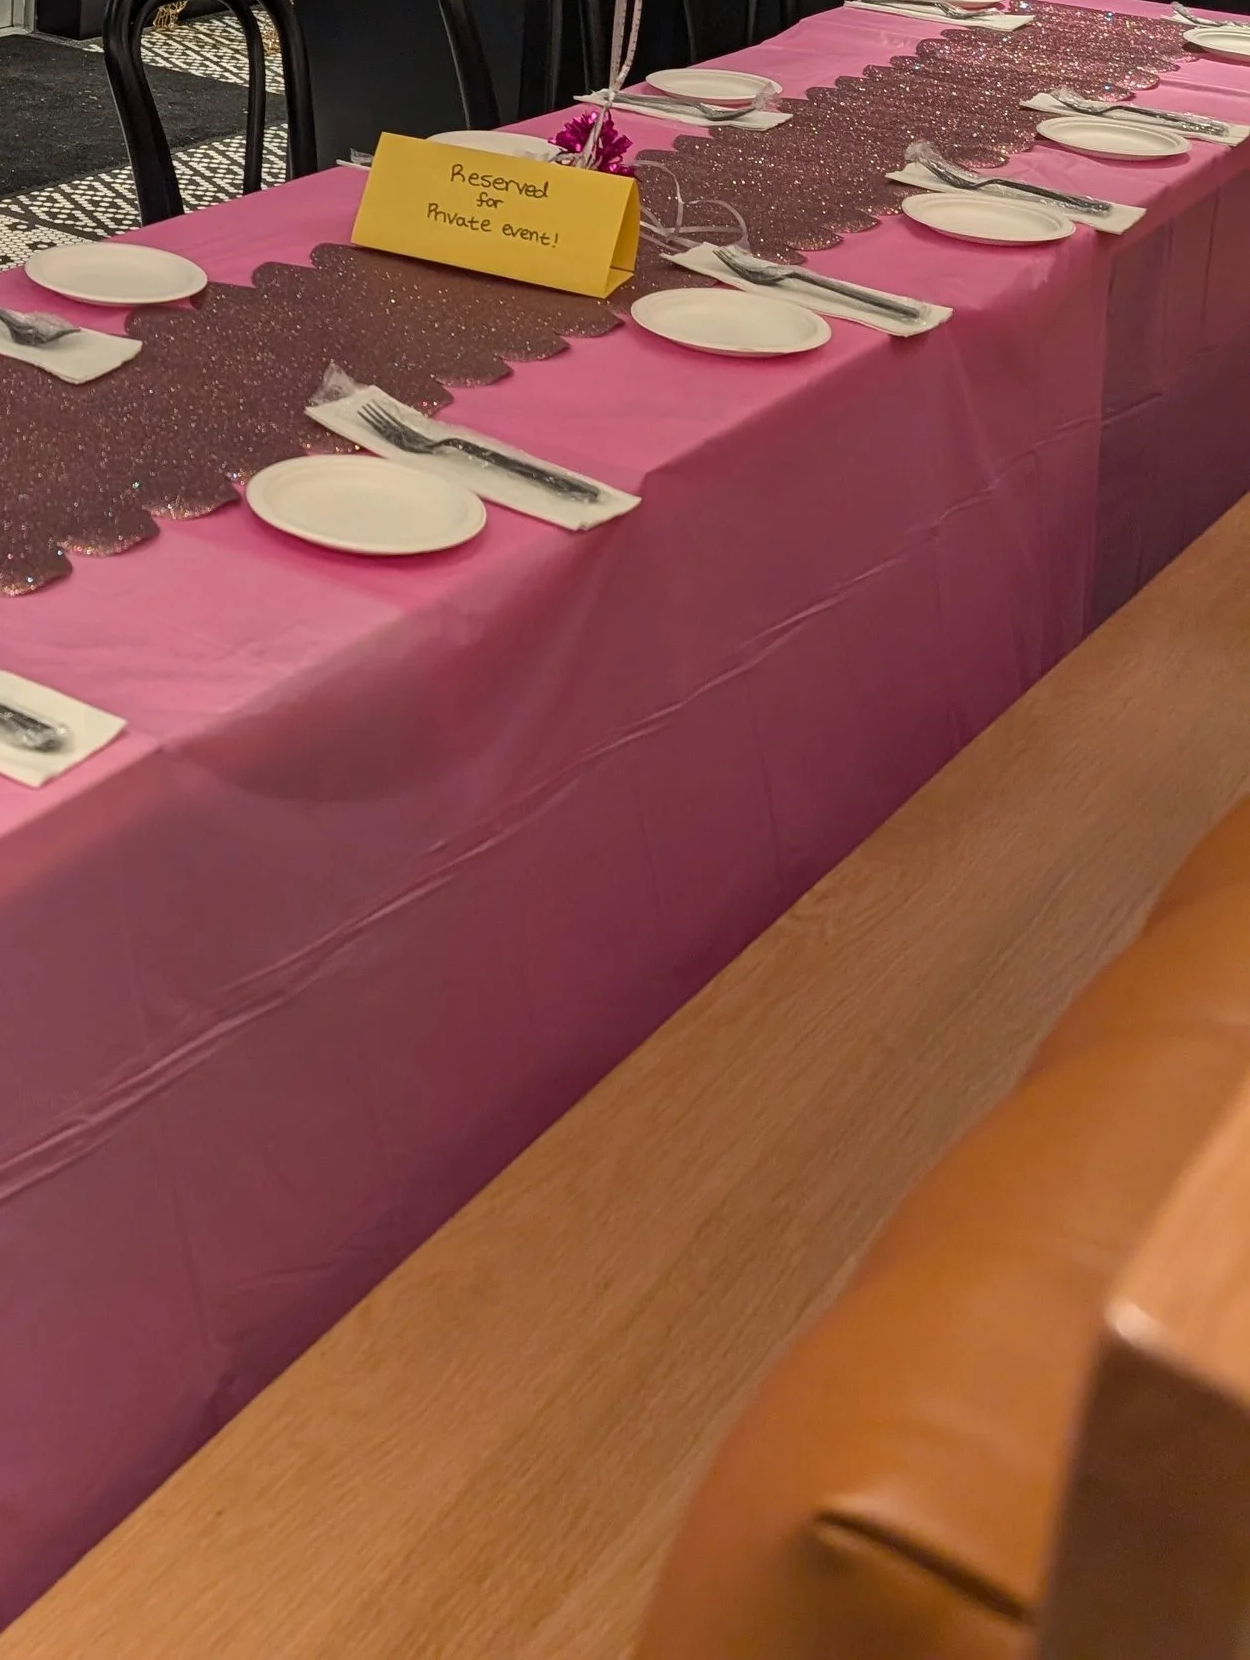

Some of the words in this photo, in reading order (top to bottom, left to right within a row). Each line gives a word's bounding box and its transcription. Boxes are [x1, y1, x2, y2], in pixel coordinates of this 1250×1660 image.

[449, 163, 550, 200] Reserved
[475, 191, 504, 210] for
[426, 202, 492, 233] Private
[501, 223, 560, 248] event!
